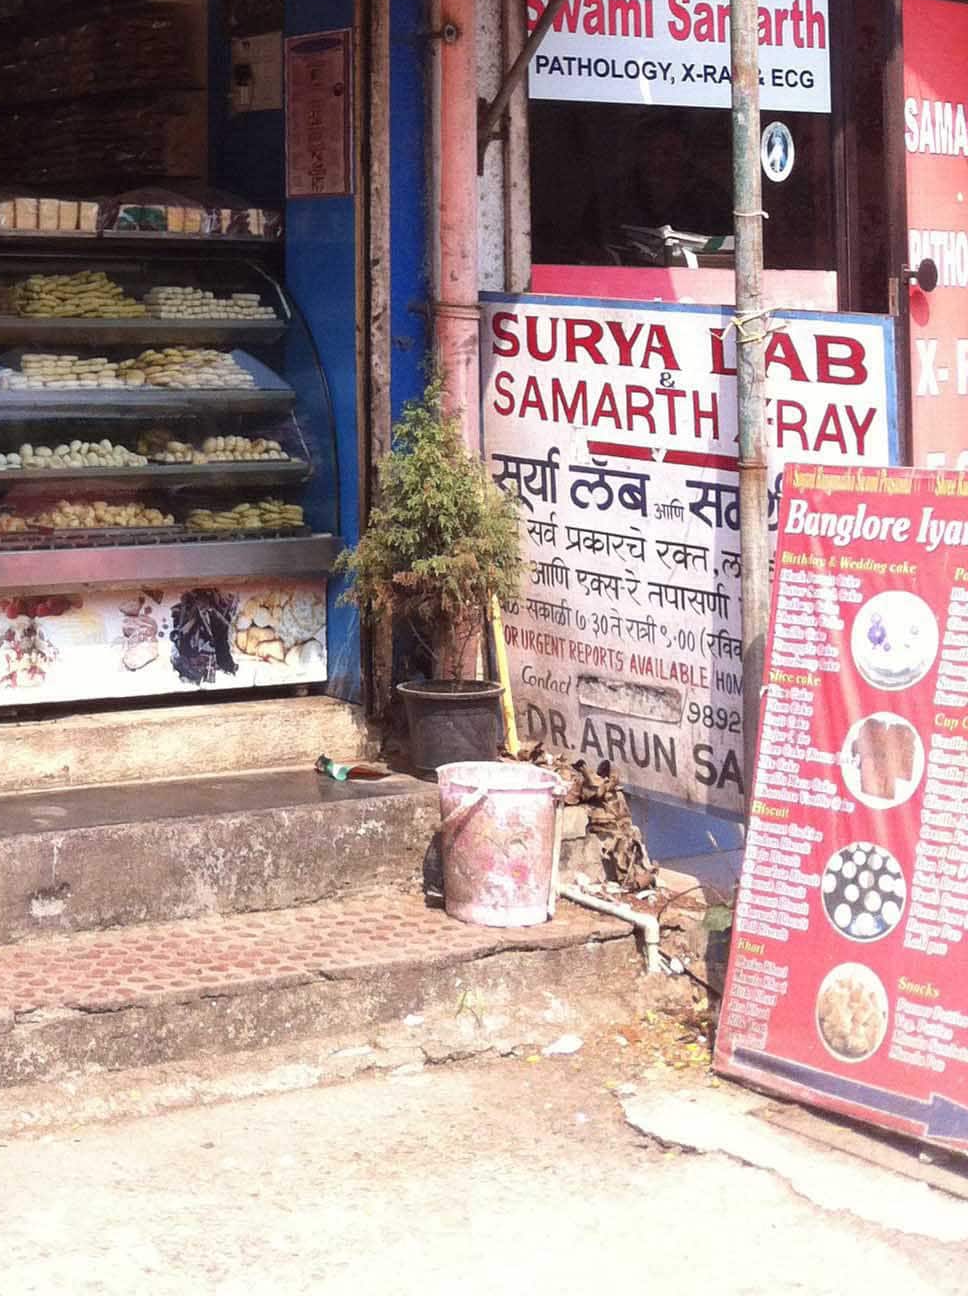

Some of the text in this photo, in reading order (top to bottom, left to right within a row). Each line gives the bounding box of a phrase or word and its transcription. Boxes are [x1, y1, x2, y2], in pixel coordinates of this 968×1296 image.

[535, 54, 675, 84] PATHOLOGY,
[771, 68, 815, 89] ECG
[492, 312, 869, 387] SURYA LAB
[659, 371, 675, 389] &
[493, 371, 719, 441] SAMARTH
[653, 498, 685, 522] आणि
[784, 499, 911, 546] Banglore
[521, 628, 566, 660] URGENT
[568, 640, 624, 673] REPORTS
[629, 654, 711, 689] AVAILABLE
[526, 702, 576, 751] DR.
[581, 716, 679, 779] ARUN
[934, 711, 959, 731] Cup
[898, 975, 941, 999] Snacks
